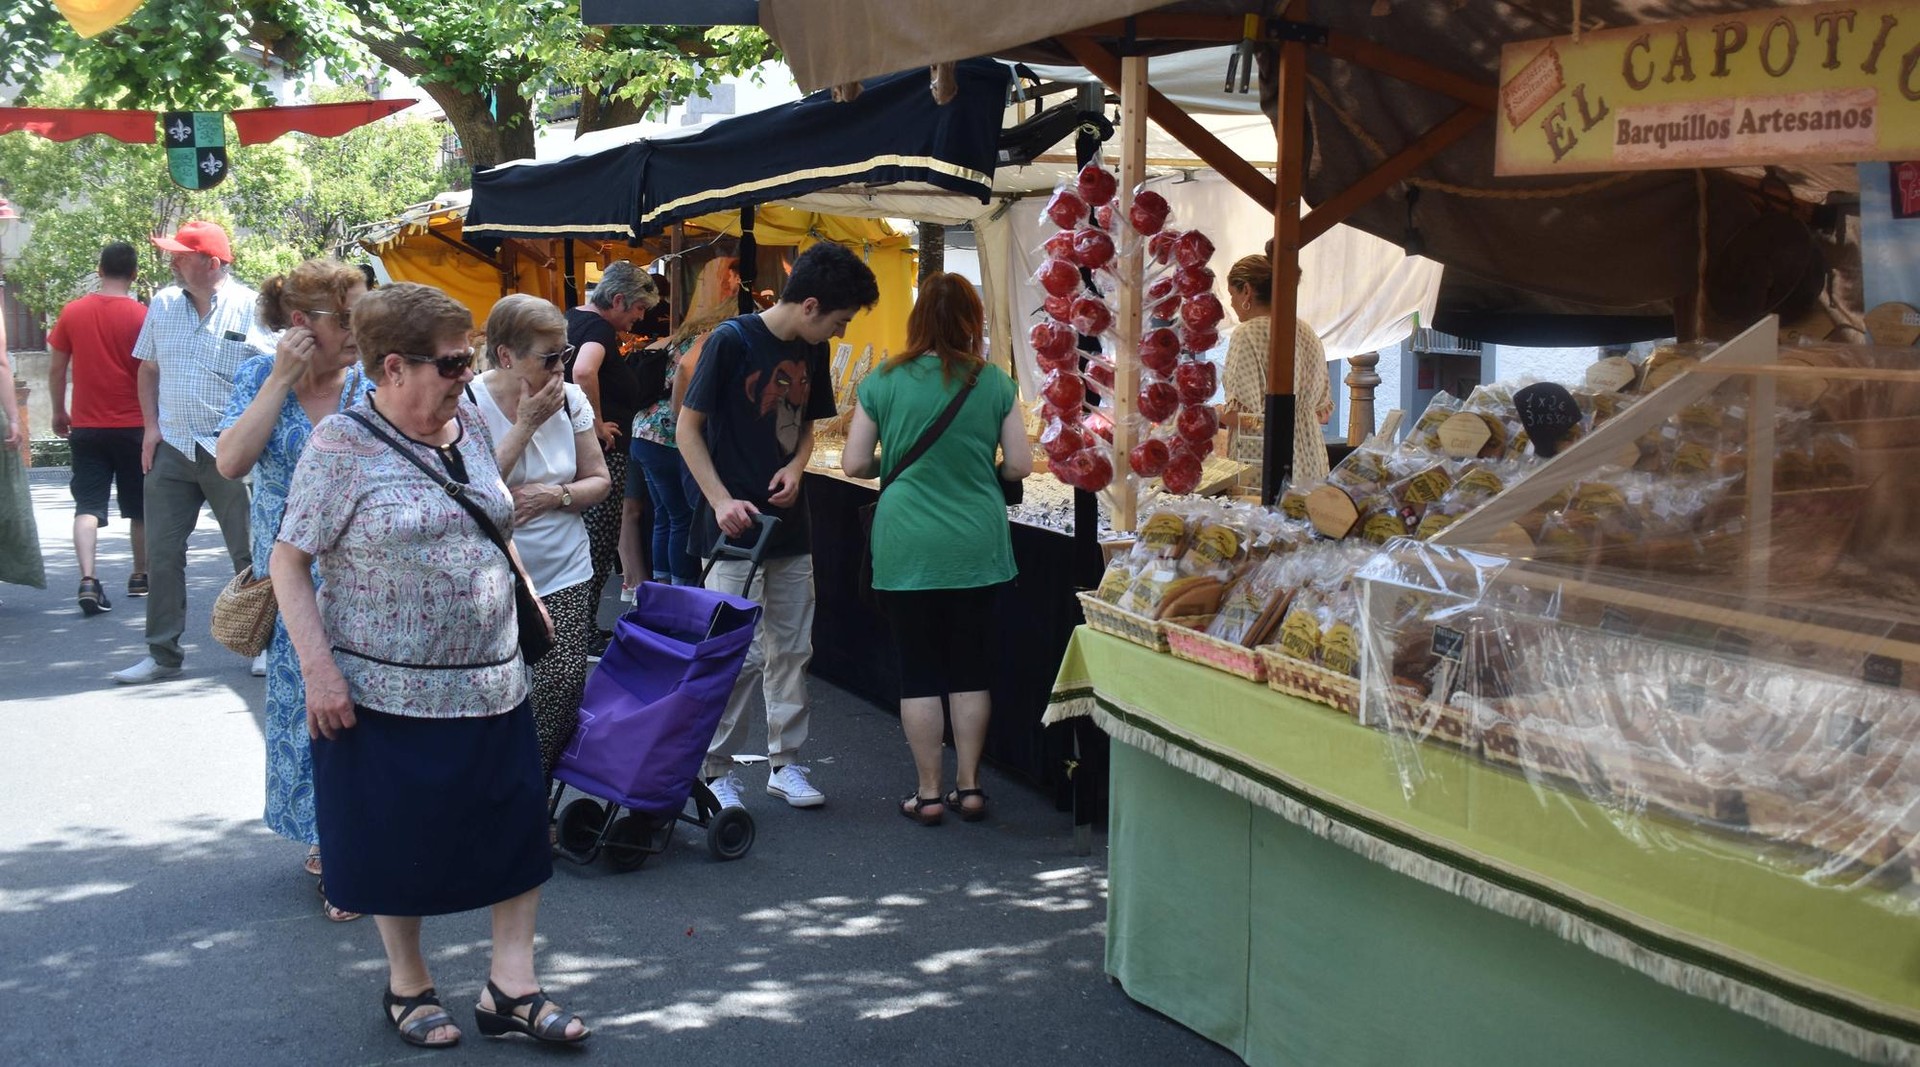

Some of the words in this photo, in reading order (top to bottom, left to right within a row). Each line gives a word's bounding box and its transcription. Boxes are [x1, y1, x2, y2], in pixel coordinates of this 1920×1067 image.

[1541, 84, 1609, 163] EL
[1616, 114, 1731, 149] Barquillos
[1736, 106, 1873, 135] Artesanos
